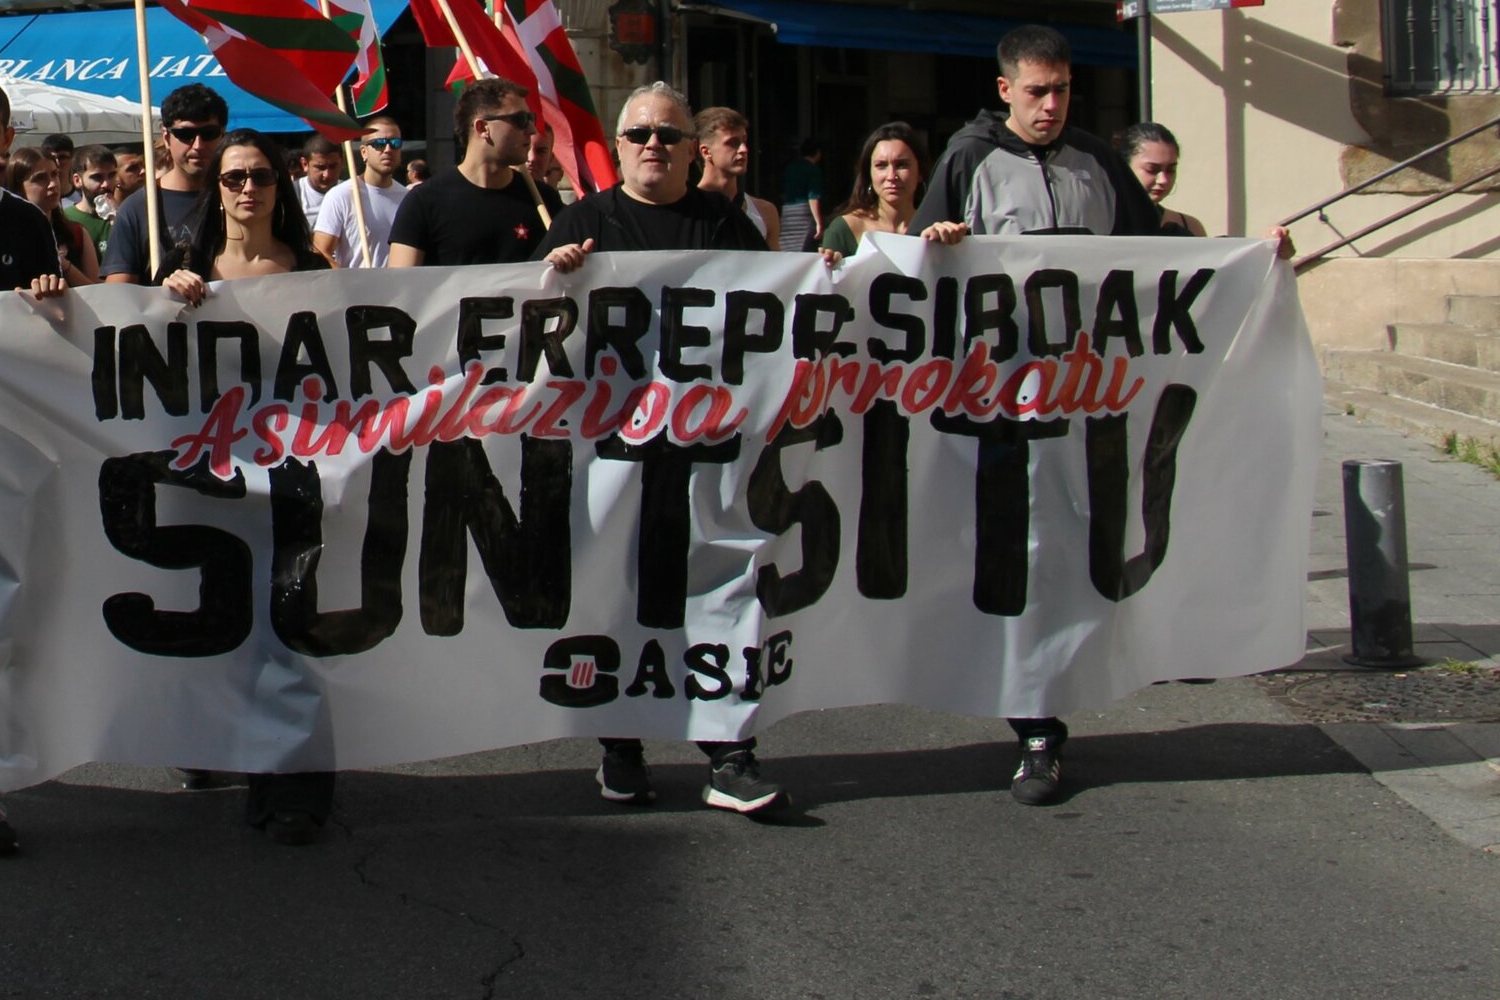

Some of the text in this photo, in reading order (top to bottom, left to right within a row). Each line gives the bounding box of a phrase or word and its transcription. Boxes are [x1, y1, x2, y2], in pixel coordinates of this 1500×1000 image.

[91, 304, 418, 423] INDAR
[171, 332, 1146, 477] Asimilazioa prrokatu
[100, 373, 1199, 658] SUNTSITU
